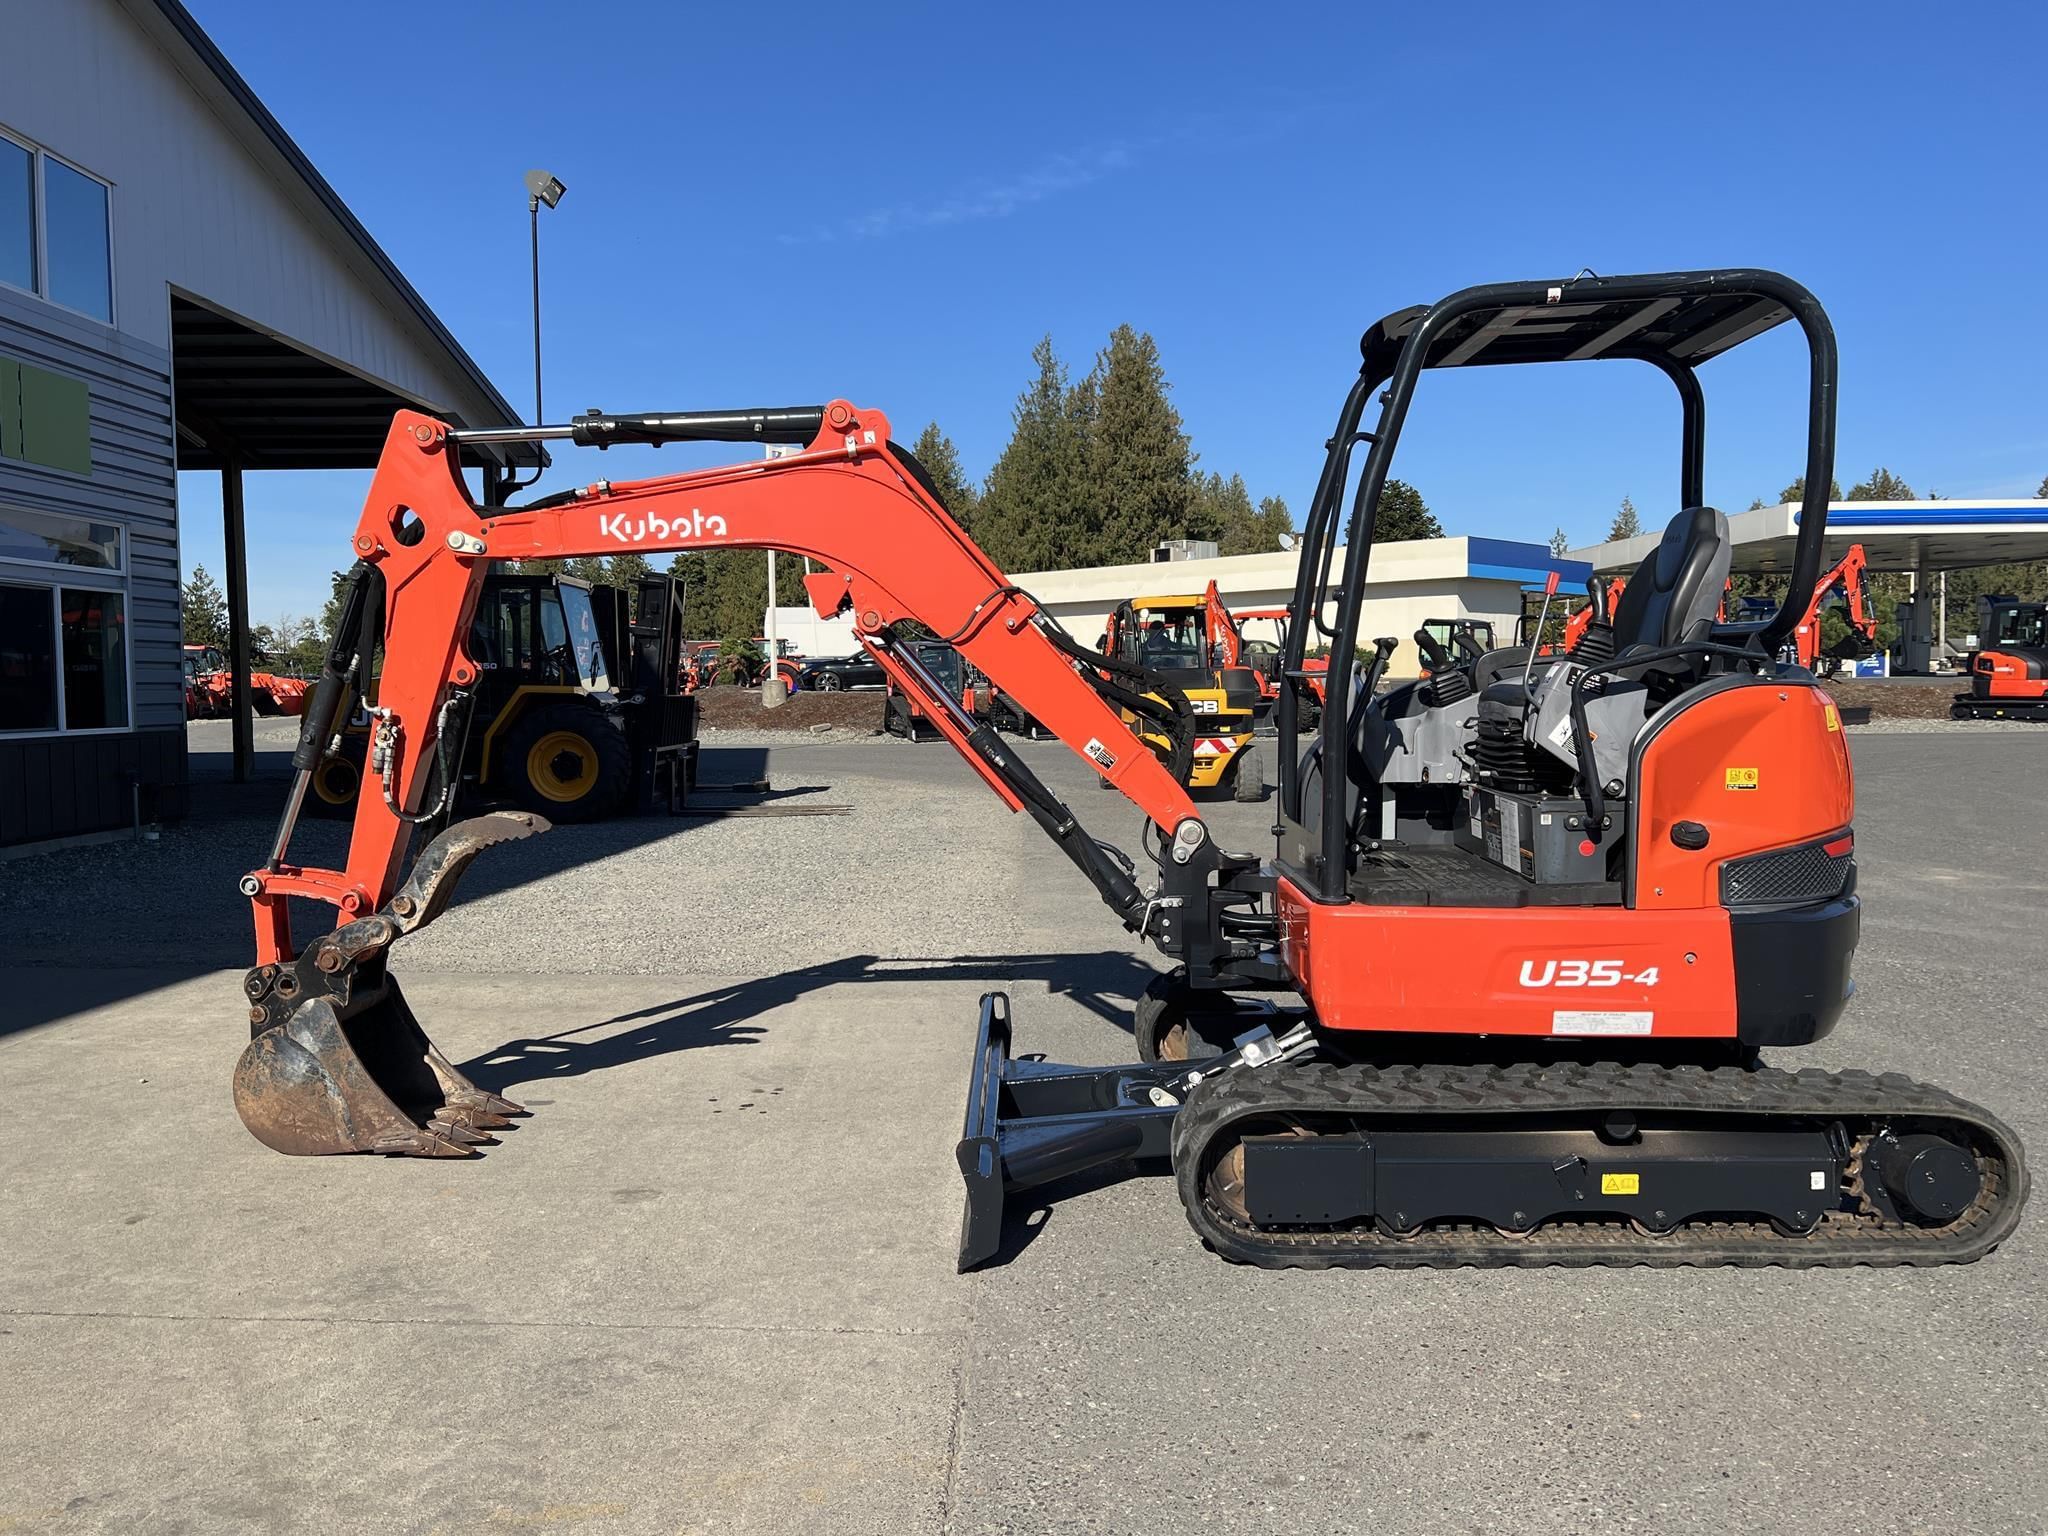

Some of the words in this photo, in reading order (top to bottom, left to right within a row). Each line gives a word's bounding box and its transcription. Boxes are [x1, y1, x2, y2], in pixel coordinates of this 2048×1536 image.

[600, 508, 727, 542] Kubota
[1190, 701, 1218, 713] CB
[1519, 960, 1659, 987] U35-4
